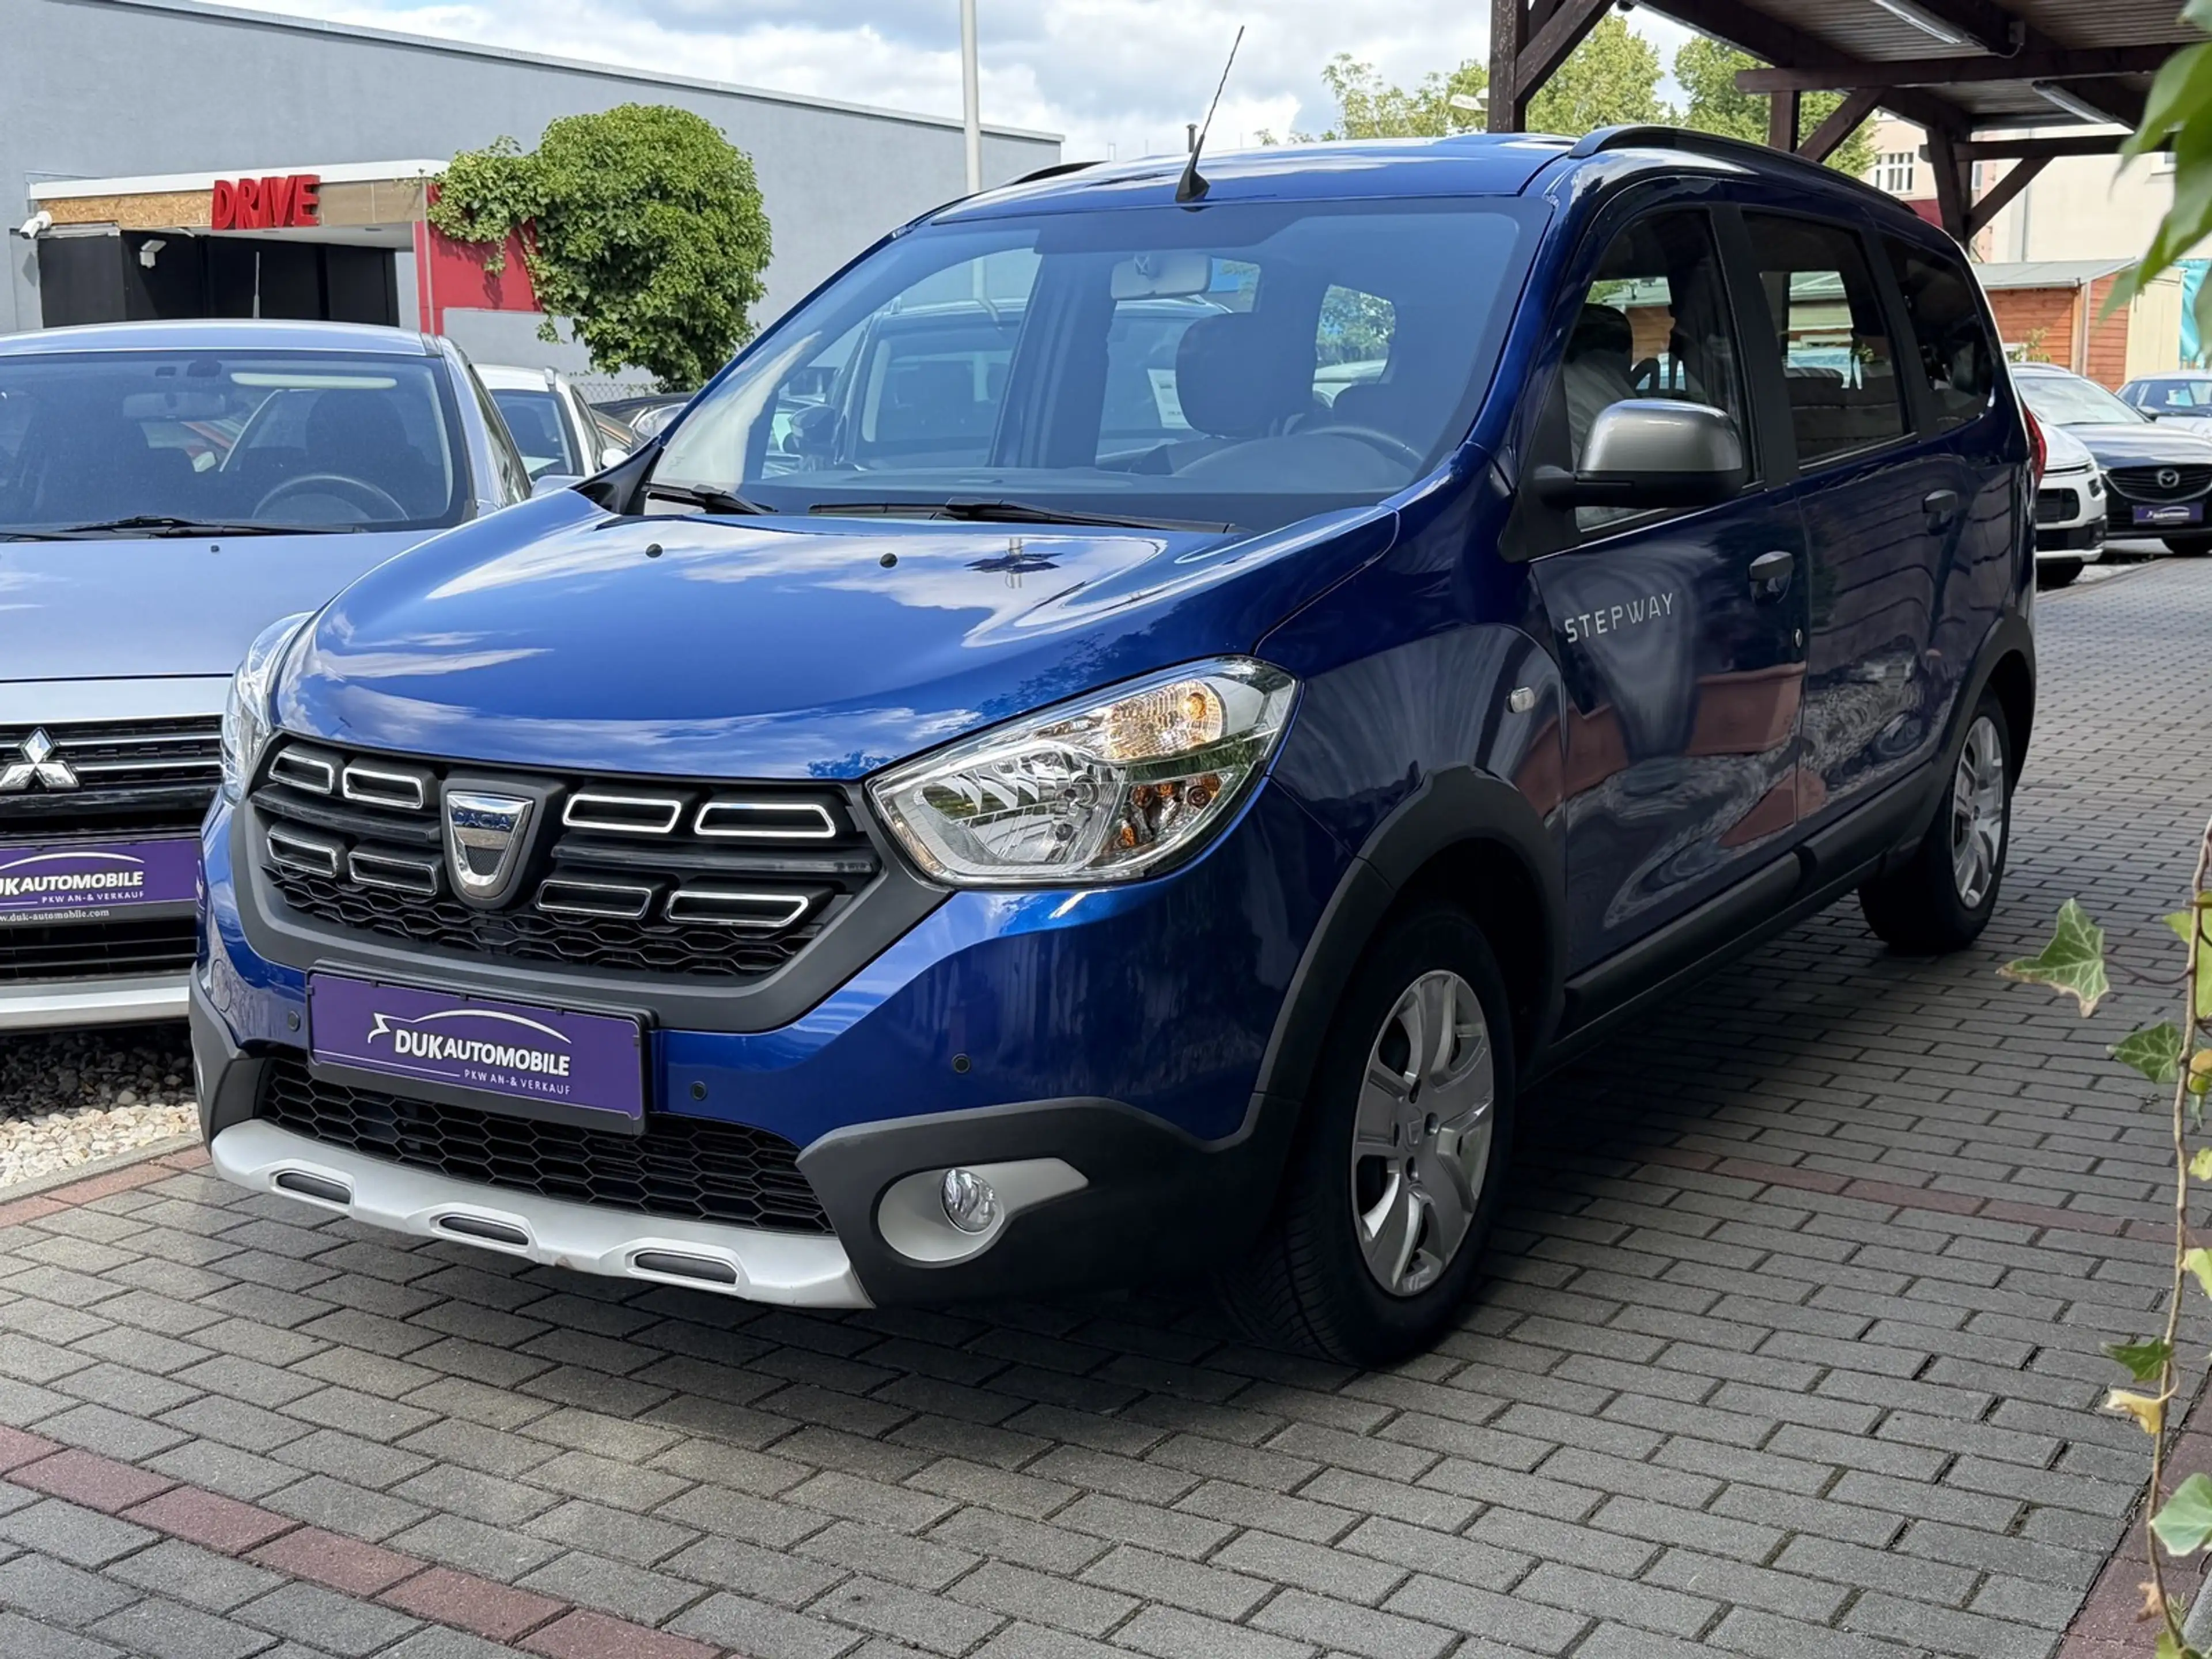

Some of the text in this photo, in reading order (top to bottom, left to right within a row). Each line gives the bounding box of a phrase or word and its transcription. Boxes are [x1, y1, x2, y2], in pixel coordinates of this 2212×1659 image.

[211, 175, 320, 230] DRIVE
[1565, 593, 1672, 643] STEPWAY
[0, 871, 144, 896] KAUTOMOBILE
[41, 895, 65, 904] PKW
[96, 891, 145, 900] VERKAUF
[395, 1029, 570, 1077] DUKAUTOMOBILE
[464, 1069, 487, 1081] PKW
[520, 1078, 571, 1095] VERKAUF
